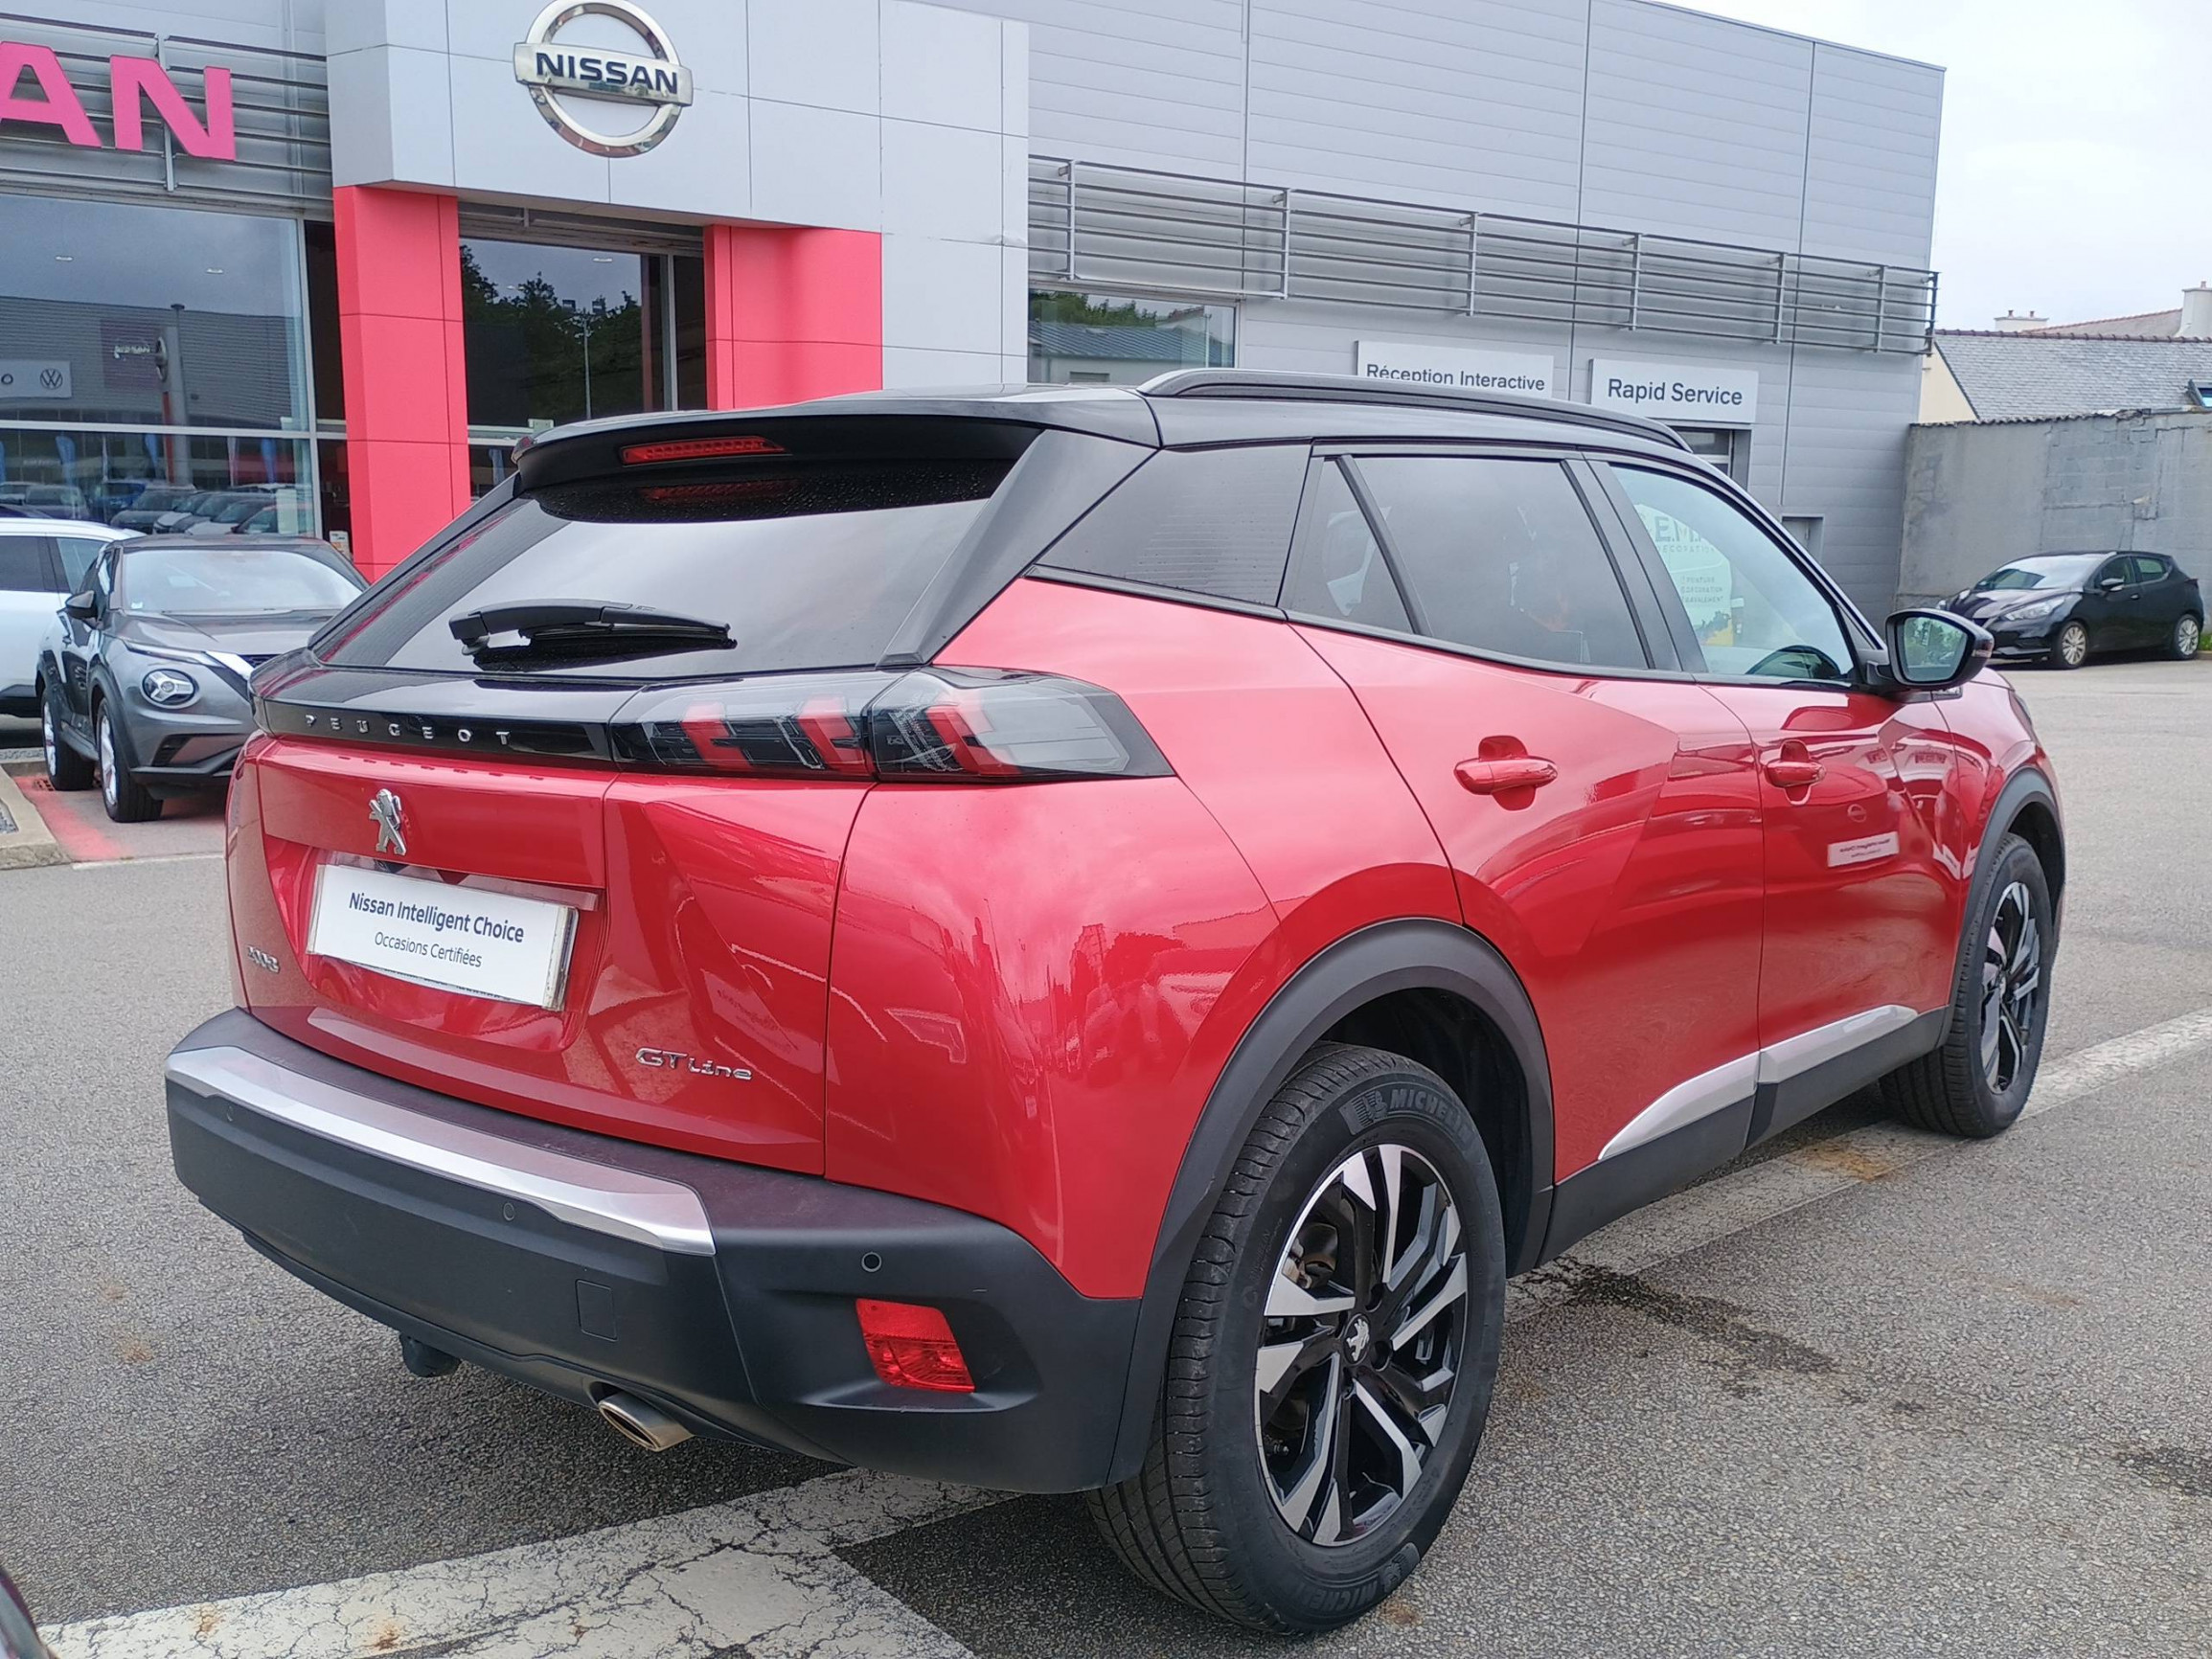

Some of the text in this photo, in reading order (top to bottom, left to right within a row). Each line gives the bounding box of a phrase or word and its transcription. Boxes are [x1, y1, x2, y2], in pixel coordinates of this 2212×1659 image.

[536, 52, 678, 95] NISSAN
[1366, 363, 1545, 391] Réception Interactive
[1608, 378, 1743, 406] Rapid Service
[305, 715, 511, 746] PEUGEOT
[349, 892, 525, 943] Nissan Intelligent Choice
[375, 931, 483, 968] Occasions Certifiées
[635, 1047, 688, 1070] GT
